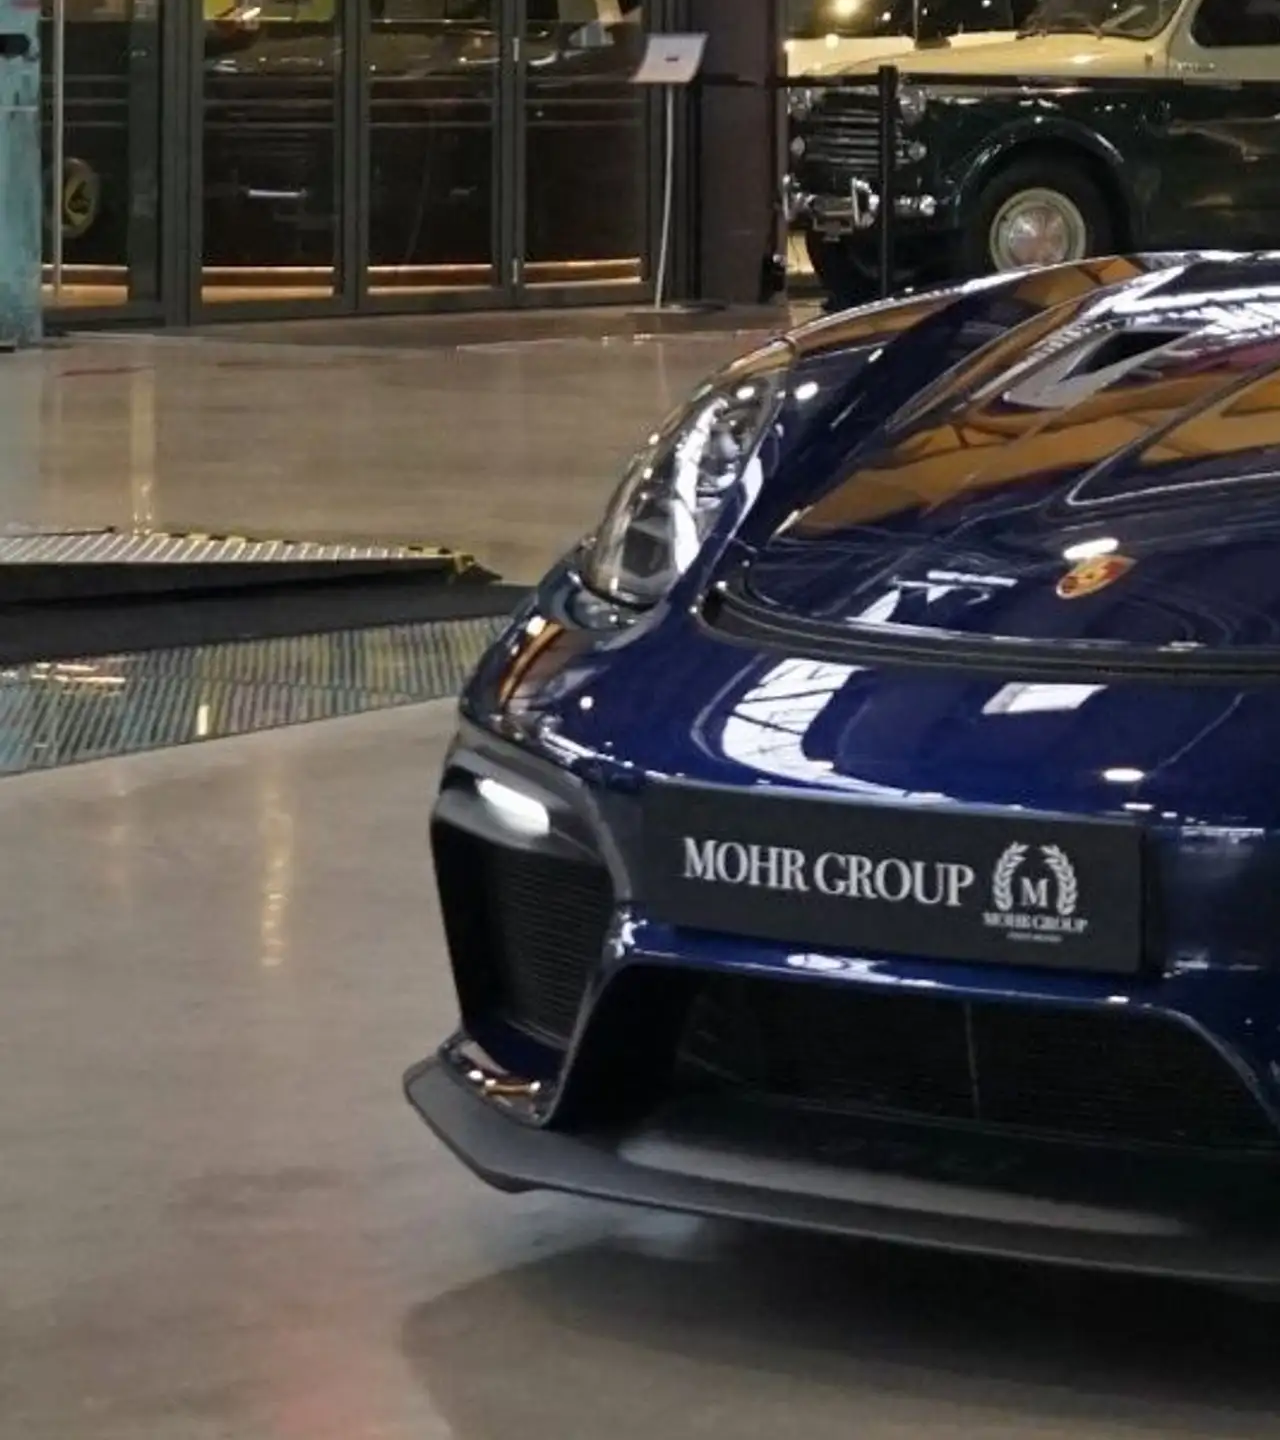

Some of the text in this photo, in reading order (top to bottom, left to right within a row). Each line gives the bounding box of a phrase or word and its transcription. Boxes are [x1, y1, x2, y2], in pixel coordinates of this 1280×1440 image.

[683, 836, 975, 907] MOHR GROUP
[1020, 876, 1049, 908] M
